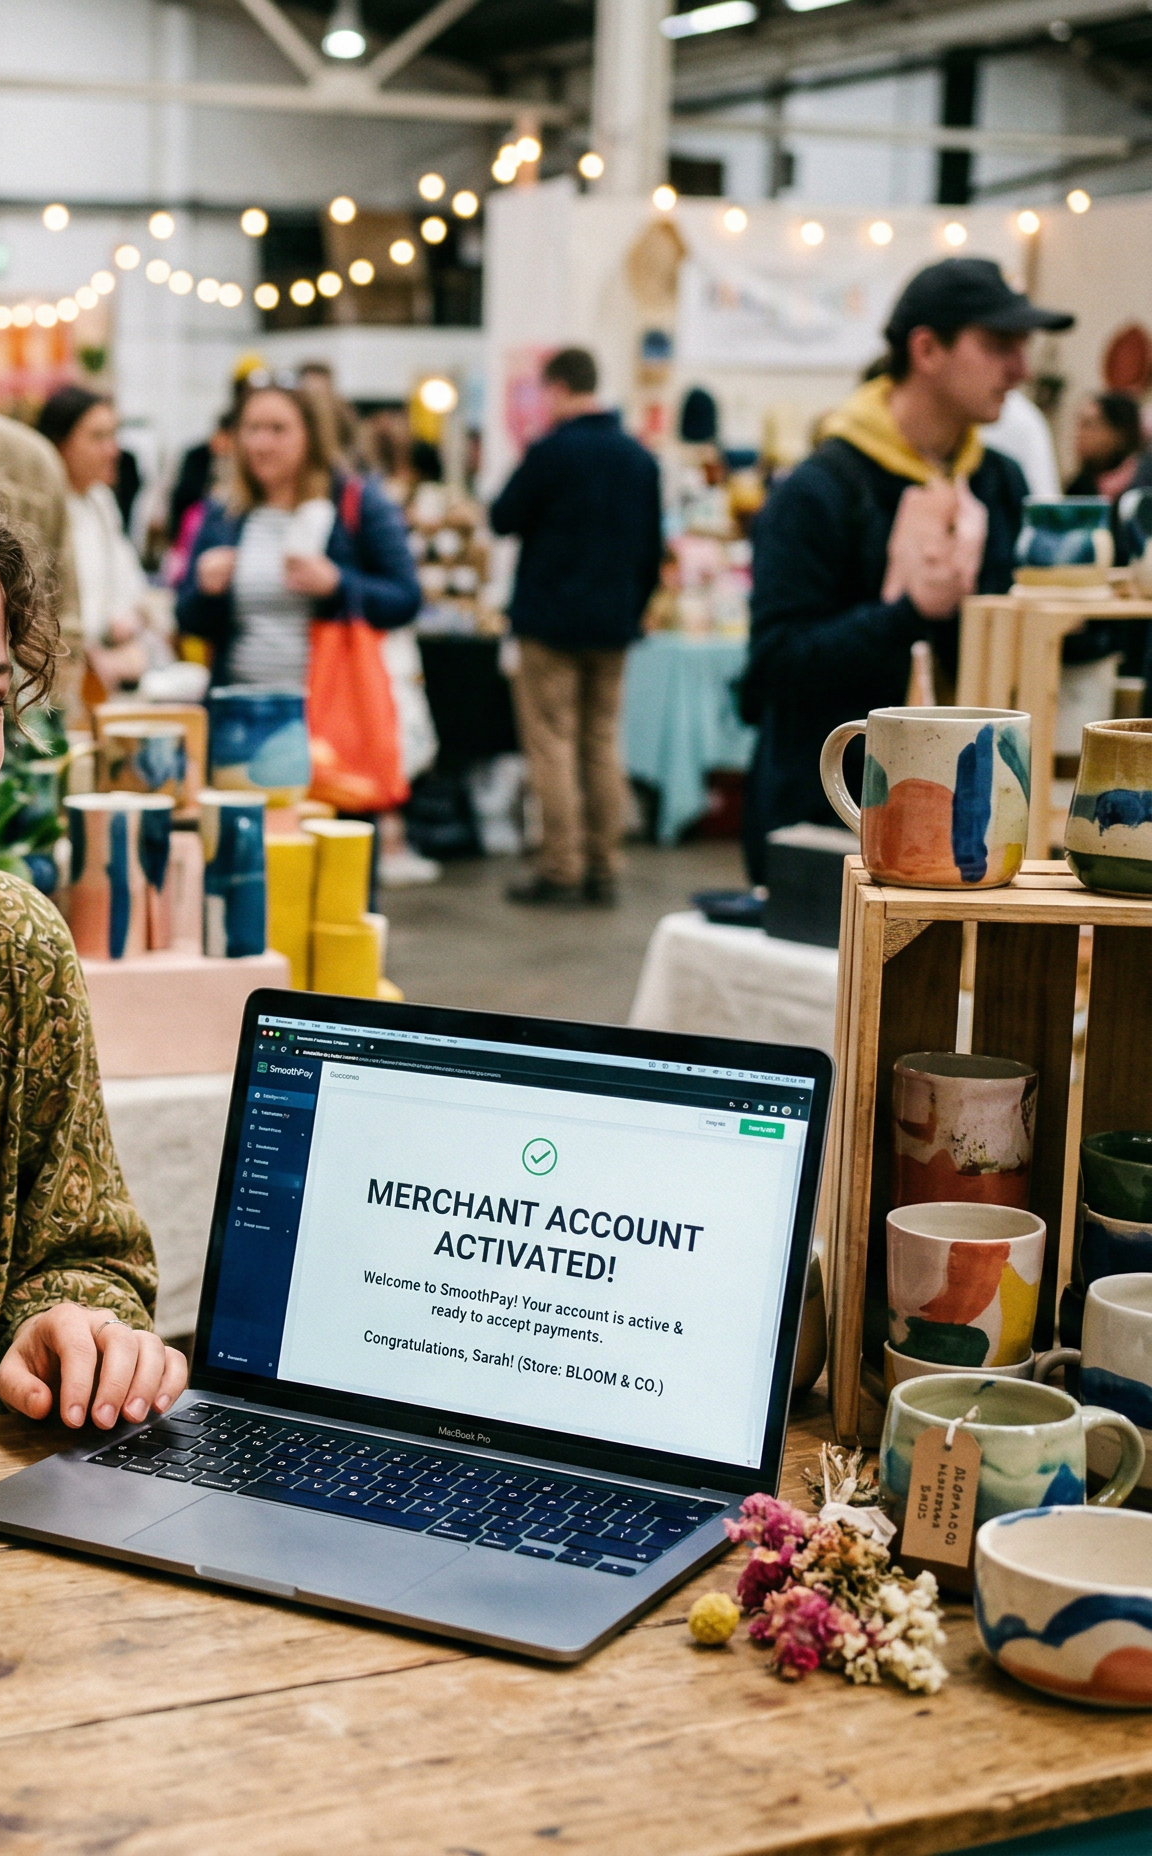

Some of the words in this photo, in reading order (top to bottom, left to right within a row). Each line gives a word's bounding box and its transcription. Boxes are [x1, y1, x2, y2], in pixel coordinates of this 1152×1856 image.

[269, 1064, 314, 1080] SmoothPay
[367, 1178, 539, 1228] MERCHANT
[545, 1205, 705, 1252] ACCOUNT
[433, 1230, 617, 1283] ACTIVATED!
[364, 1270, 421, 1293] Welcome
[424, 1280, 437, 1294] to
[440, 1282, 518, 1310] SmoothPay!
[522, 1295, 553, 1313] Your
[555, 1304, 610, 1323] account
[612, 1311, 625, 1325] is
[628, 1316, 670, 1333] active
[673, 1320, 684, 1335] &
[431, 1304, 468, 1324] ready
[470, 1309, 483, 1323] to
[486, 1314, 532, 1333] accept
[533, 1322, 604, 1344] payments.
[364, 1329, 468, 1363] Congratulations,
[472, 1348, 515, 1368] Sarah!
[517, 1354, 562, 1376] (Store:
[565, 1364, 617, 1386] BLOOM
[620, 1374, 631, 1389] &
[634, 1376, 664, 1397] CO.)
